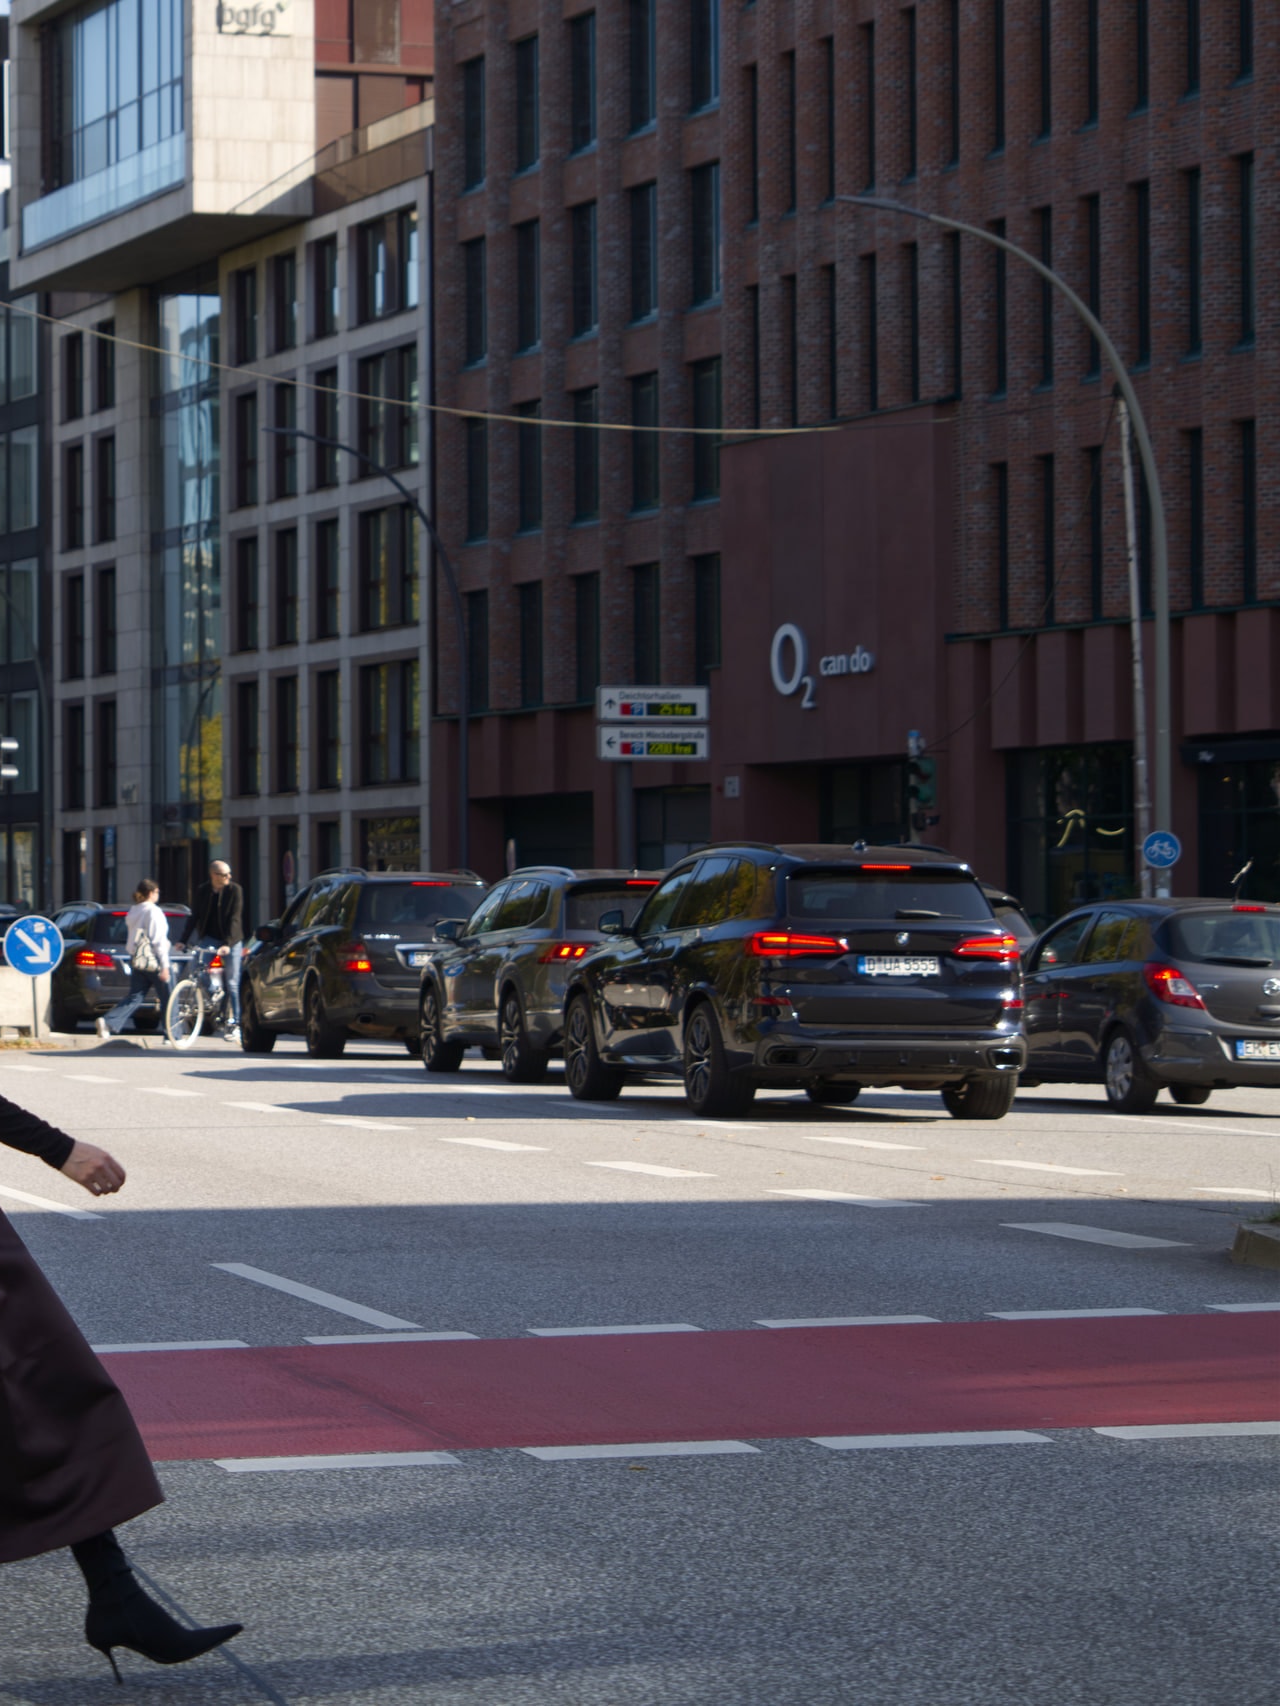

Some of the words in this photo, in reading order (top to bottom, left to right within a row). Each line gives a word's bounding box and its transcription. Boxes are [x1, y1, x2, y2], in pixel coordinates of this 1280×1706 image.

[819, 654, 847, 676] can
[849, 645, 872, 673] do
[619, 690, 682, 700] Deichtorhallen
[674, 703, 694, 715] frei
[619, 730, 644, 739] Bereich
[645, 730, 705, 742] Mönckebergstraße
[674, 742, 694, 755] frei
[867, 958, 876, 971] D
[883, 957, 900, 971] UA
[904, 957, 937, 971] 5555
